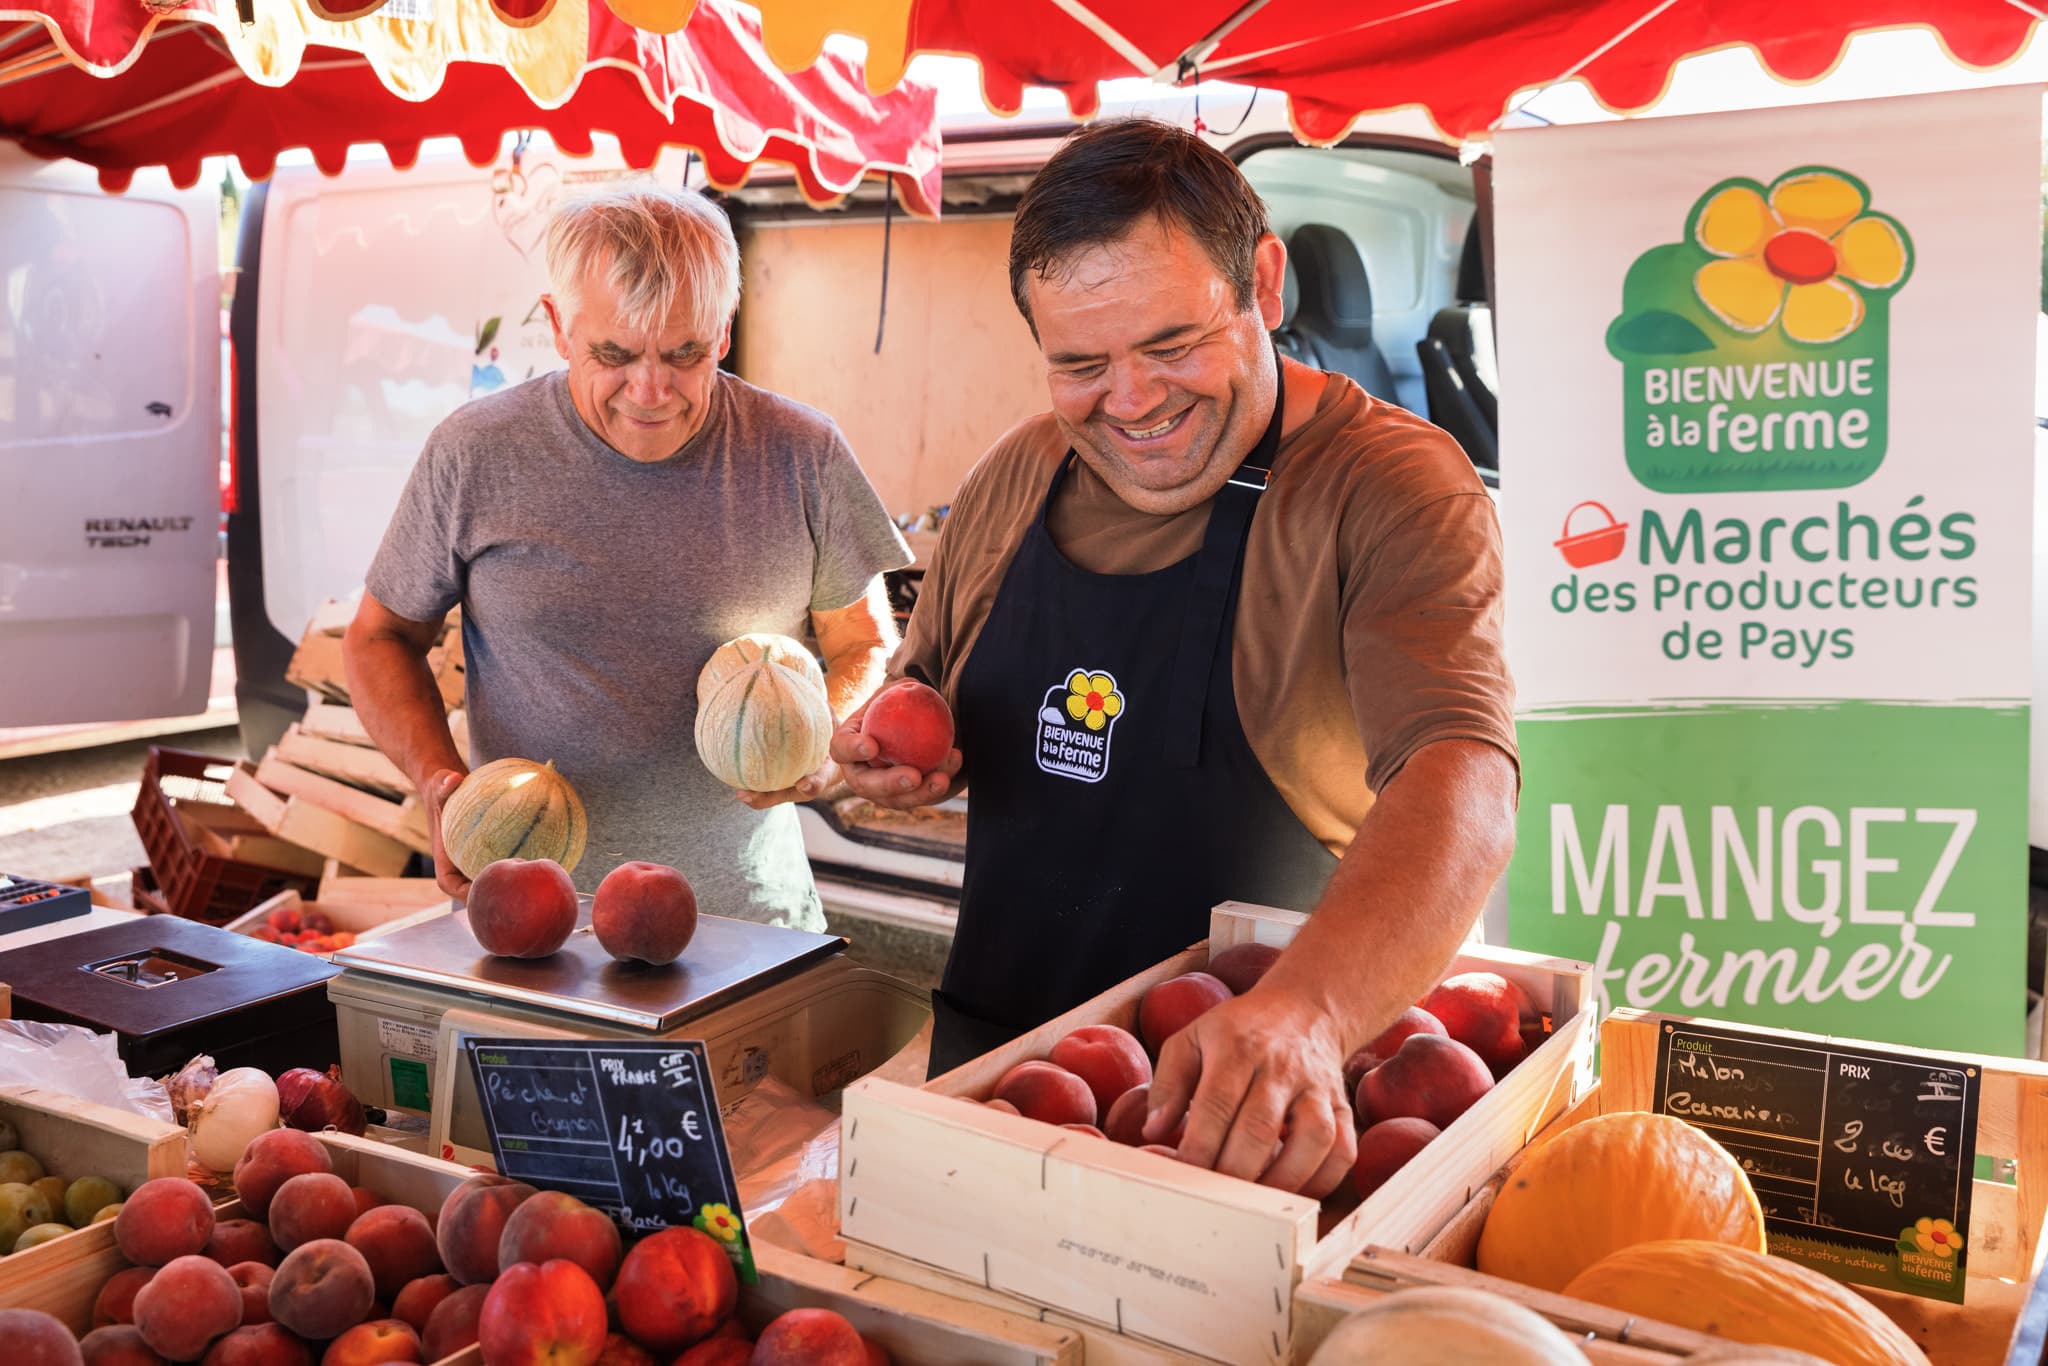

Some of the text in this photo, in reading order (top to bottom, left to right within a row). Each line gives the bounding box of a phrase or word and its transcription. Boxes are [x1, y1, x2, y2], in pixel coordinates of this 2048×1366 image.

[1644, 358, 1875, 405] BIENVENUE
[1646, 404, 1871, 454] à la ferme
[85, 516, 195, 533] RENAULT
[1638, 495, 1977, 566] Marchés
[1551, 571, 1979, 614] des Producteurs
[1661, 621, 1855, 669] de Pays
[1044, 725, 1105, 751] BIENVENUE
[1058, 741, 1102, 768] ferme
[1550, 803, 1977, 928] MANGEZ
[1593, 920, 1952, 1020] fermier
[1677, 1039, 1713, 1053] Produit
[600, 1058, 625, 1072] PRIX
[612, 1069, 657, 1086] FRANCE
[1839, 1063, 1871, 1080] PRIX
[1924, 1127, 1947, 1156] €
[1808, 1249, 1840, 1263] notre
[1845, 1256, 1888, 1272] nature
[1903, 1253, 1953, 1270] BIENVENUE
[1915, 1265, 1952, 1282] ferme
